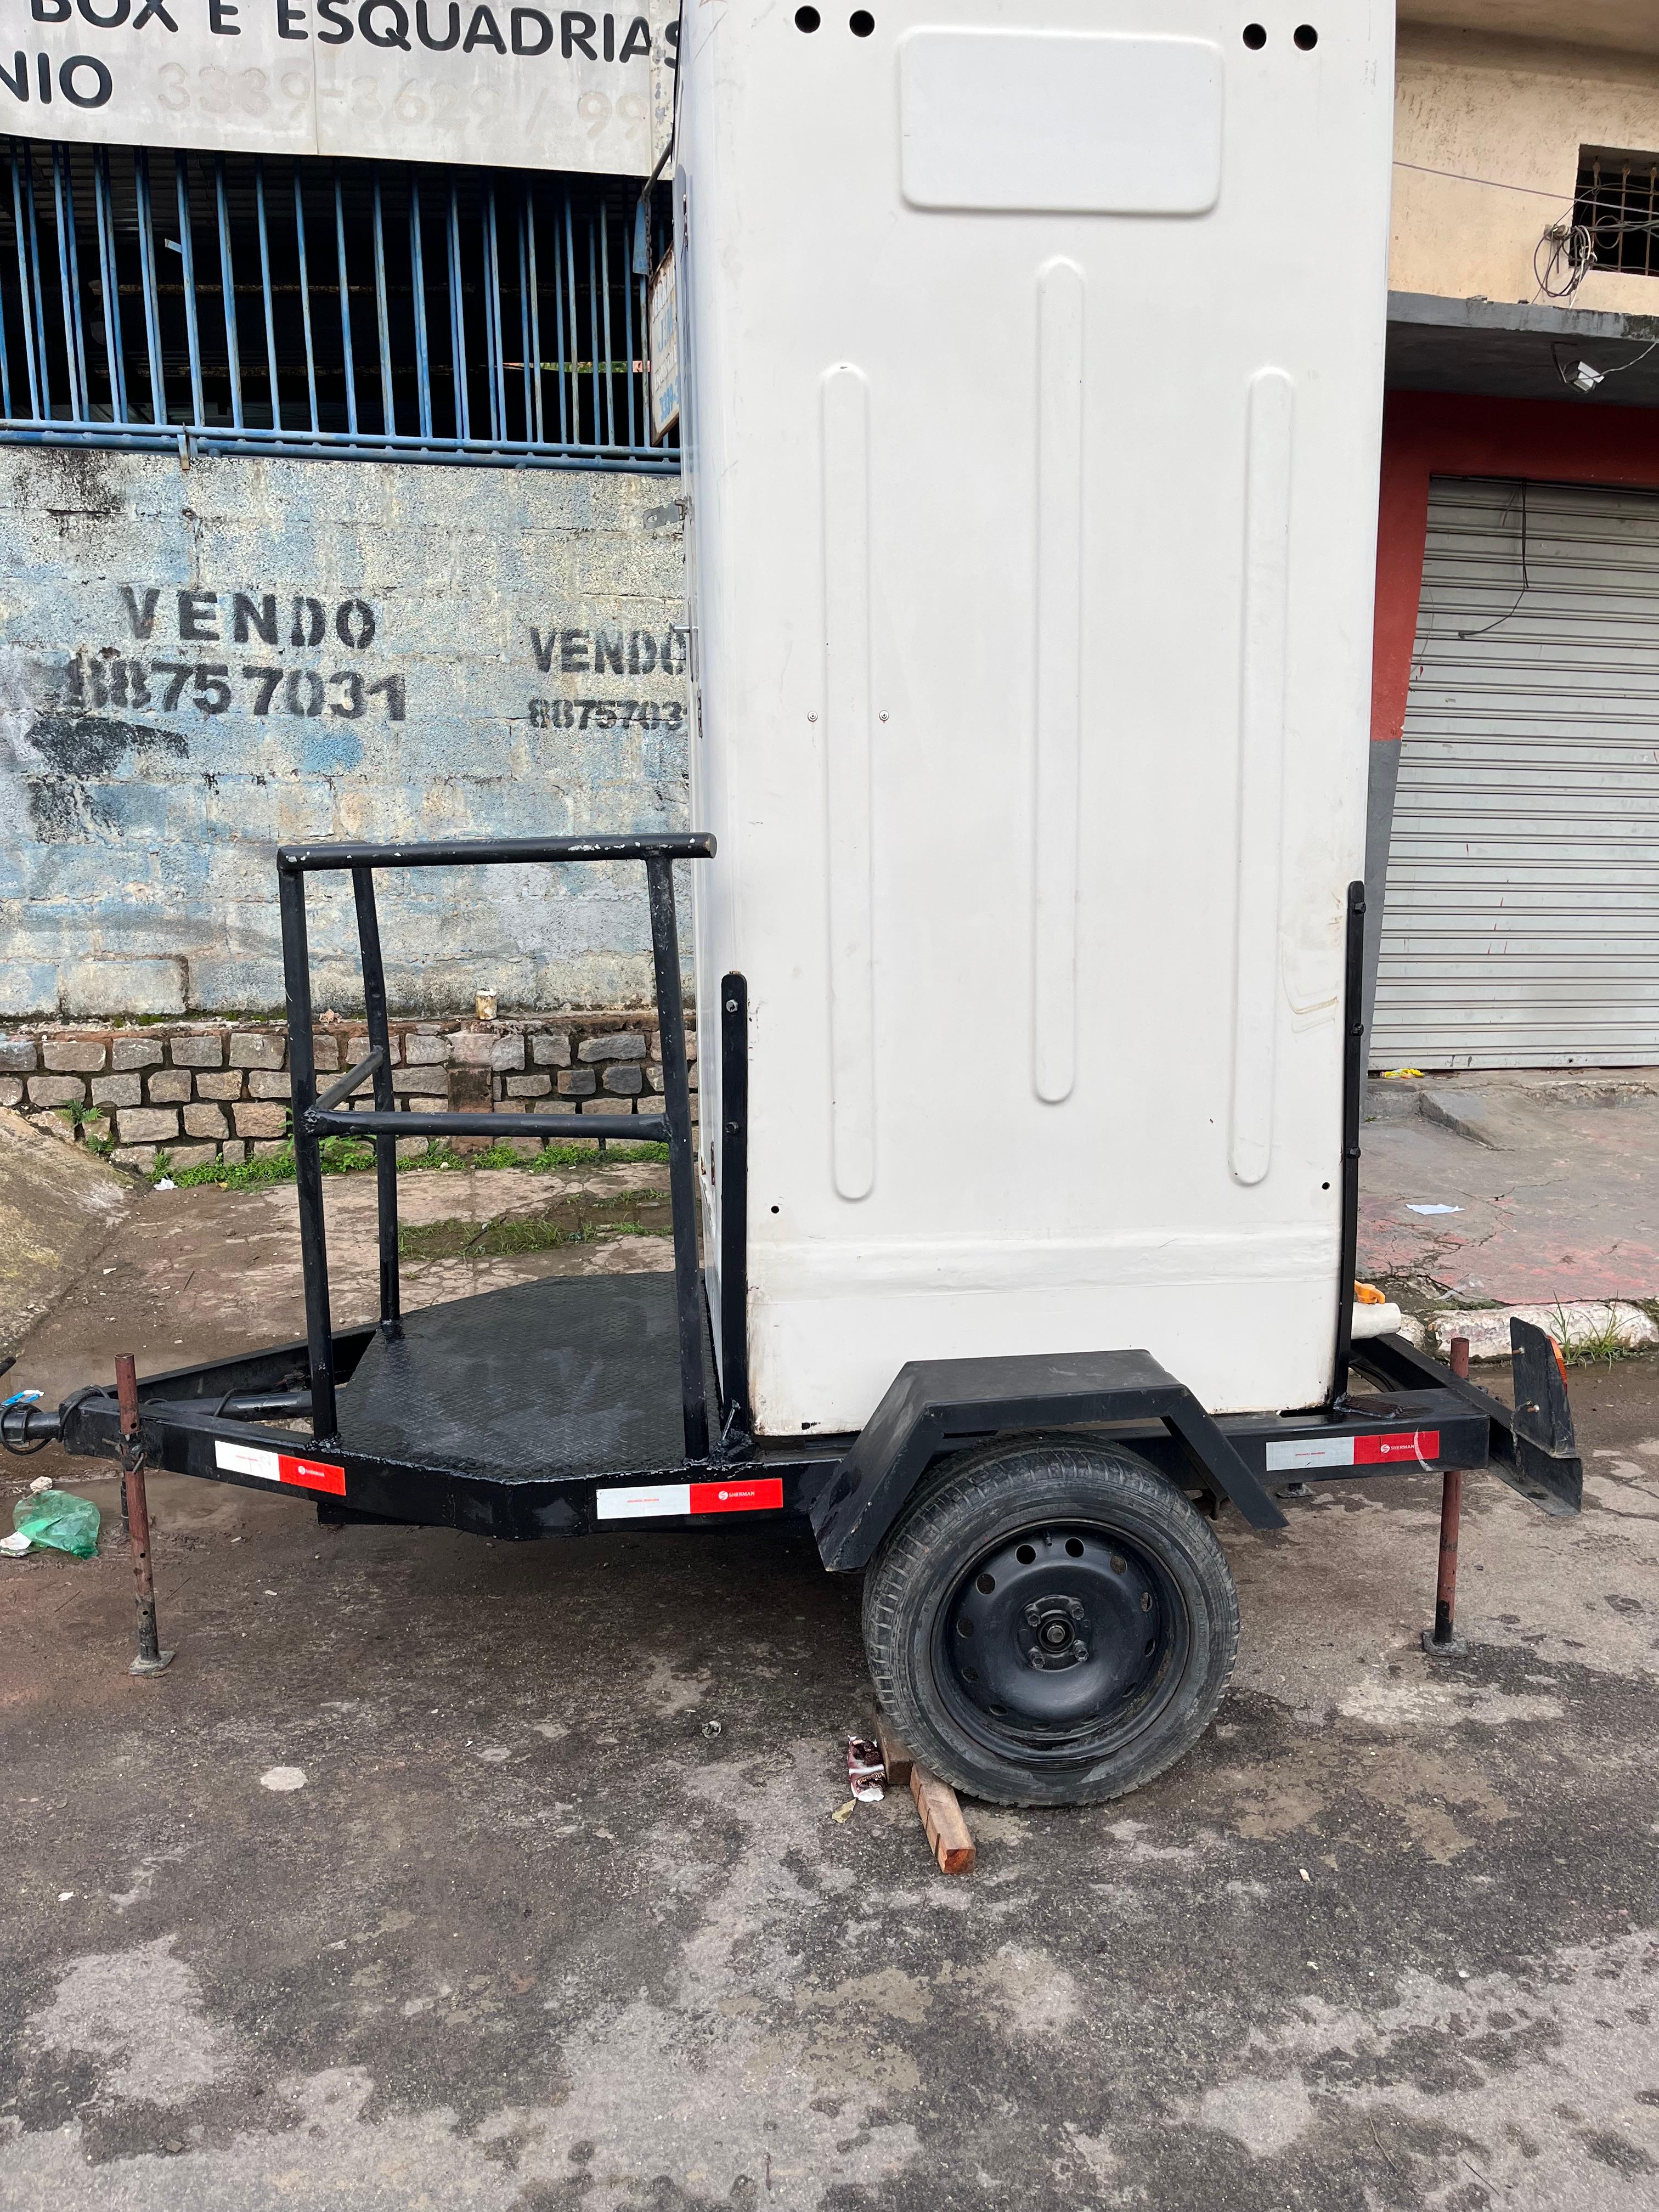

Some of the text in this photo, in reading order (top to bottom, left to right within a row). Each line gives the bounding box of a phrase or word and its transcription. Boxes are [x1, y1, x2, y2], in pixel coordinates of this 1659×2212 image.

[209, 0, 241, 35] E
[121, 586, 376, 650] VENDO
[531, 628, 686, 675] VENDO
